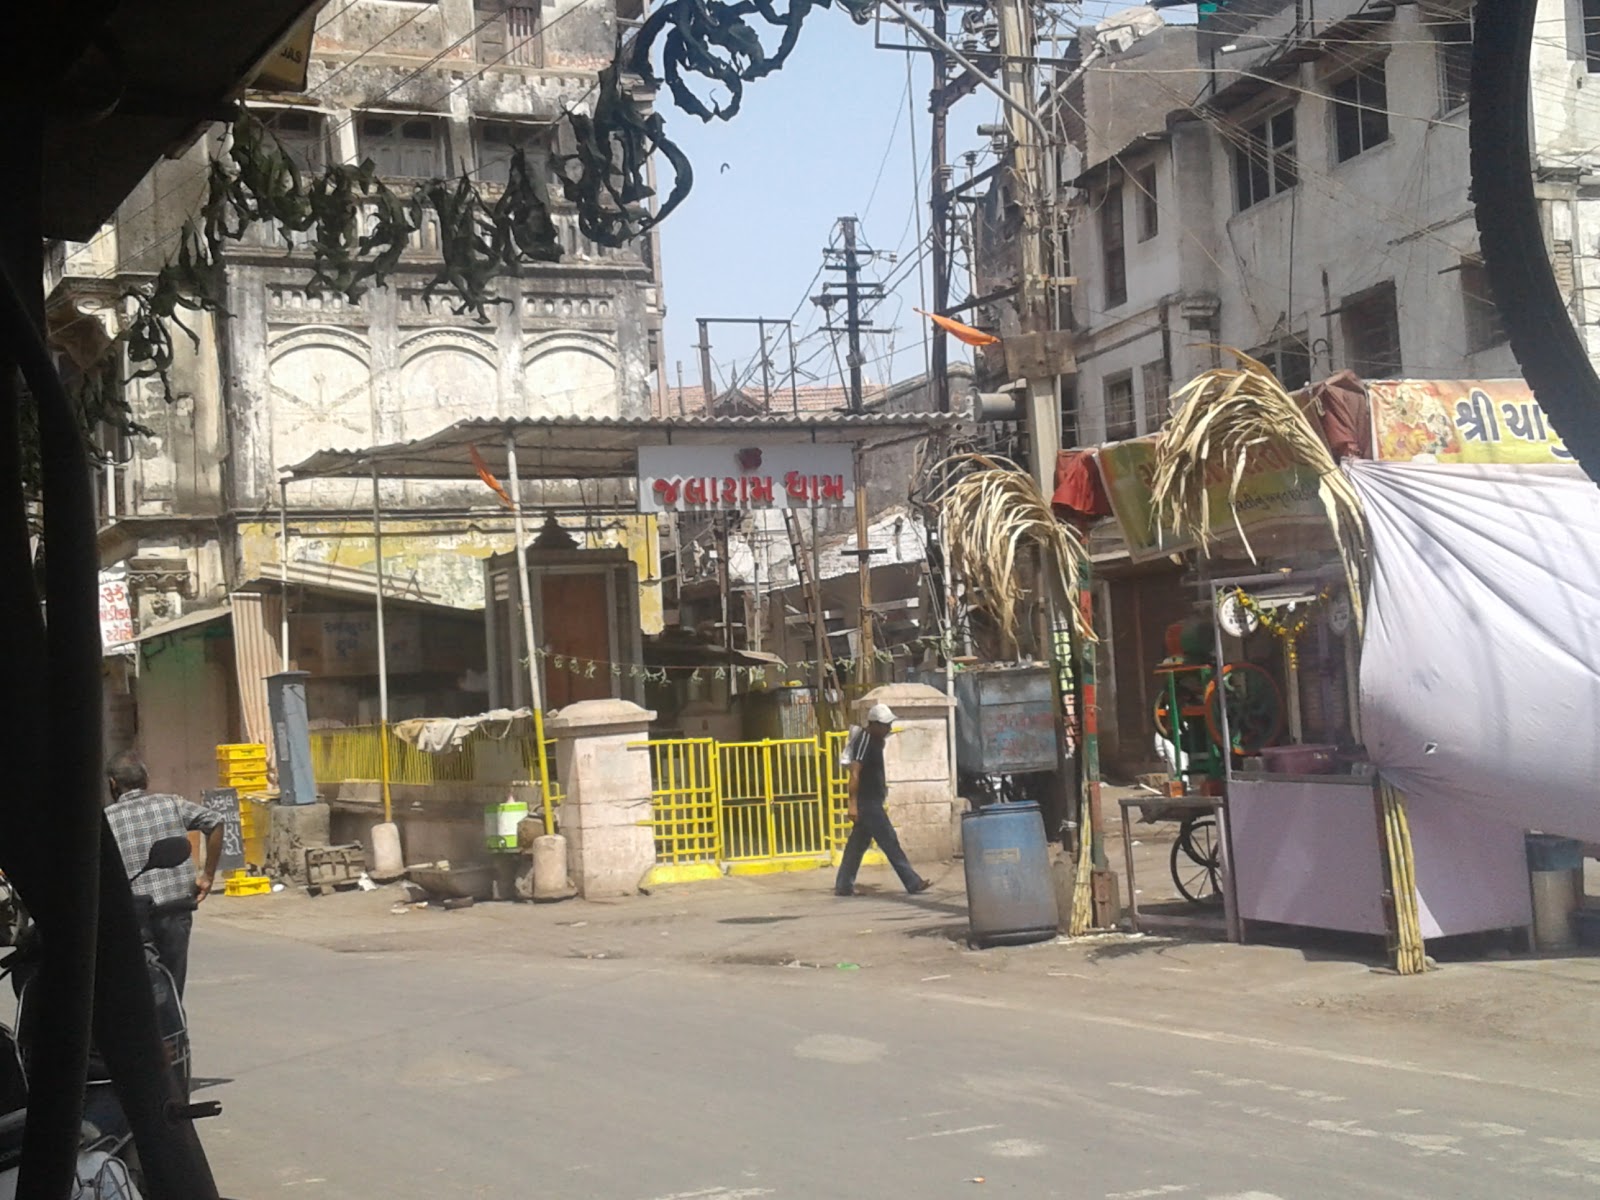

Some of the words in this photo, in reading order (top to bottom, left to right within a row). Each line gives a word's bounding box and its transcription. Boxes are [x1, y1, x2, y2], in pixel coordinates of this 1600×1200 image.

[1455, 390, 1500, 441] શ્રી
[652, 475, 775, 504] જલારામ
[784, 470, 845, 501] ધામ
